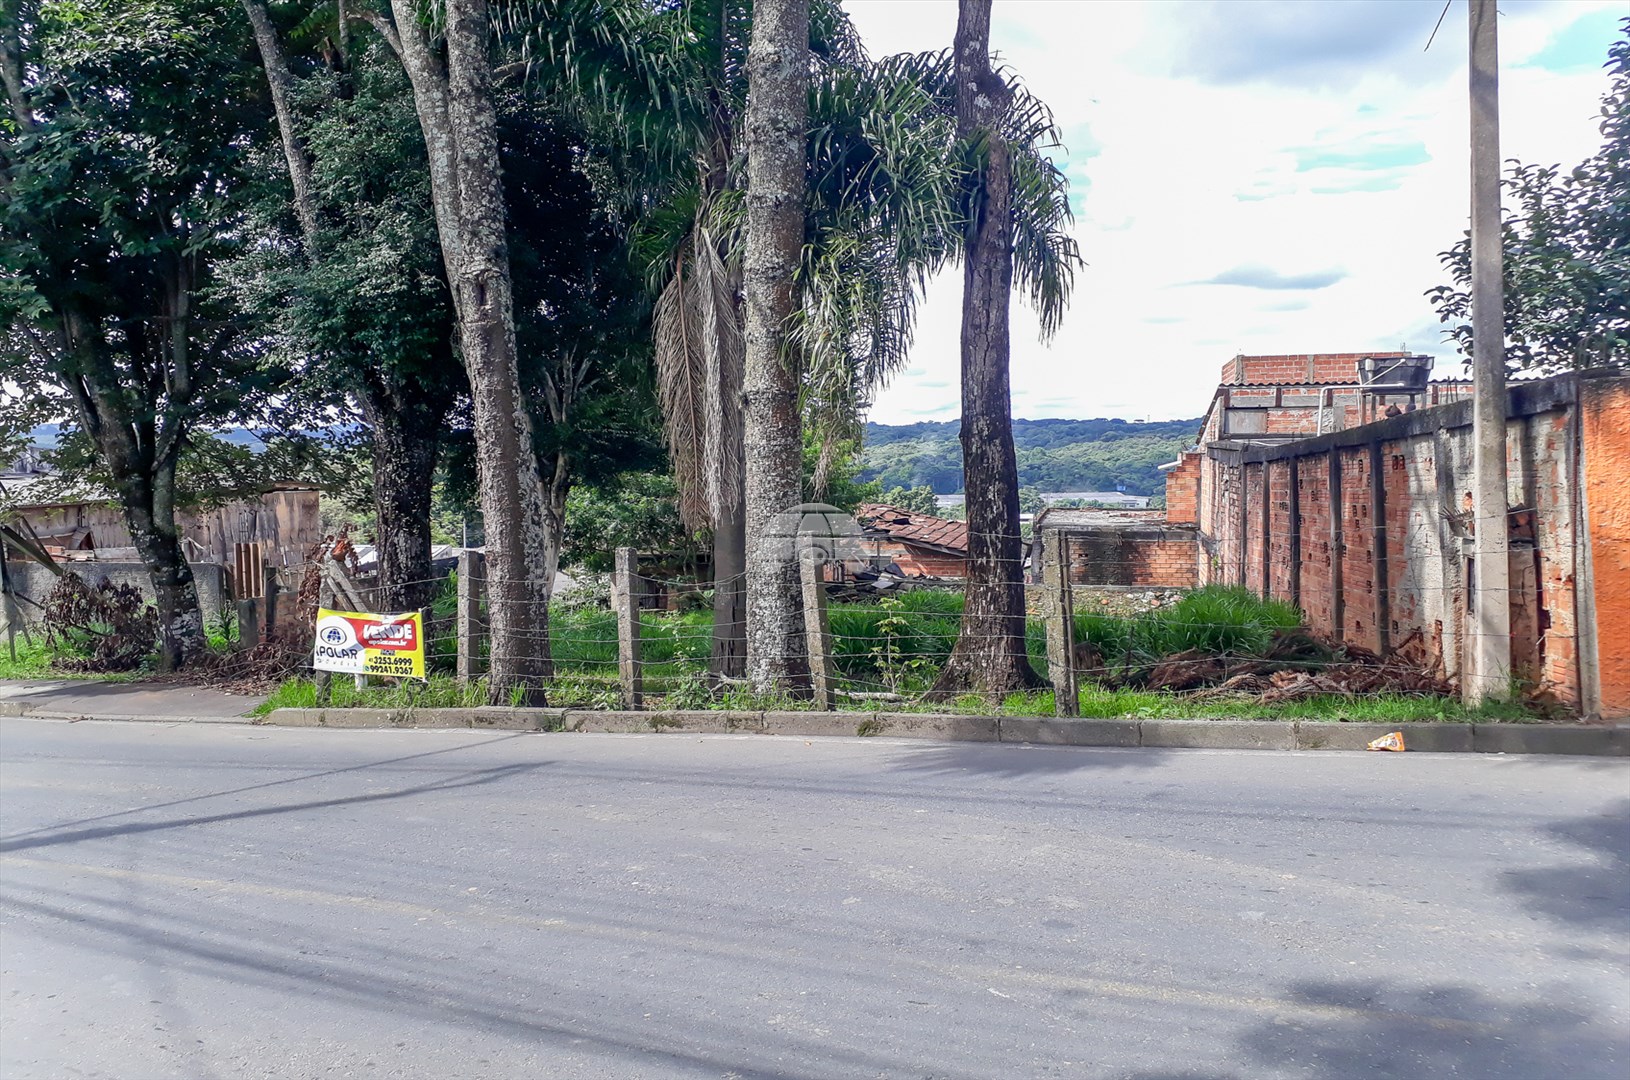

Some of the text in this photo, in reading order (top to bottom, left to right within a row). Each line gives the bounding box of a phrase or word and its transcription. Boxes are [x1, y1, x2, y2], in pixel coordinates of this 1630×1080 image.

[363, 623, 413, 640] VENDE
[373, 656, 412, 666] 3253.6999
[370, 665, 413, 675] 99241.9367
